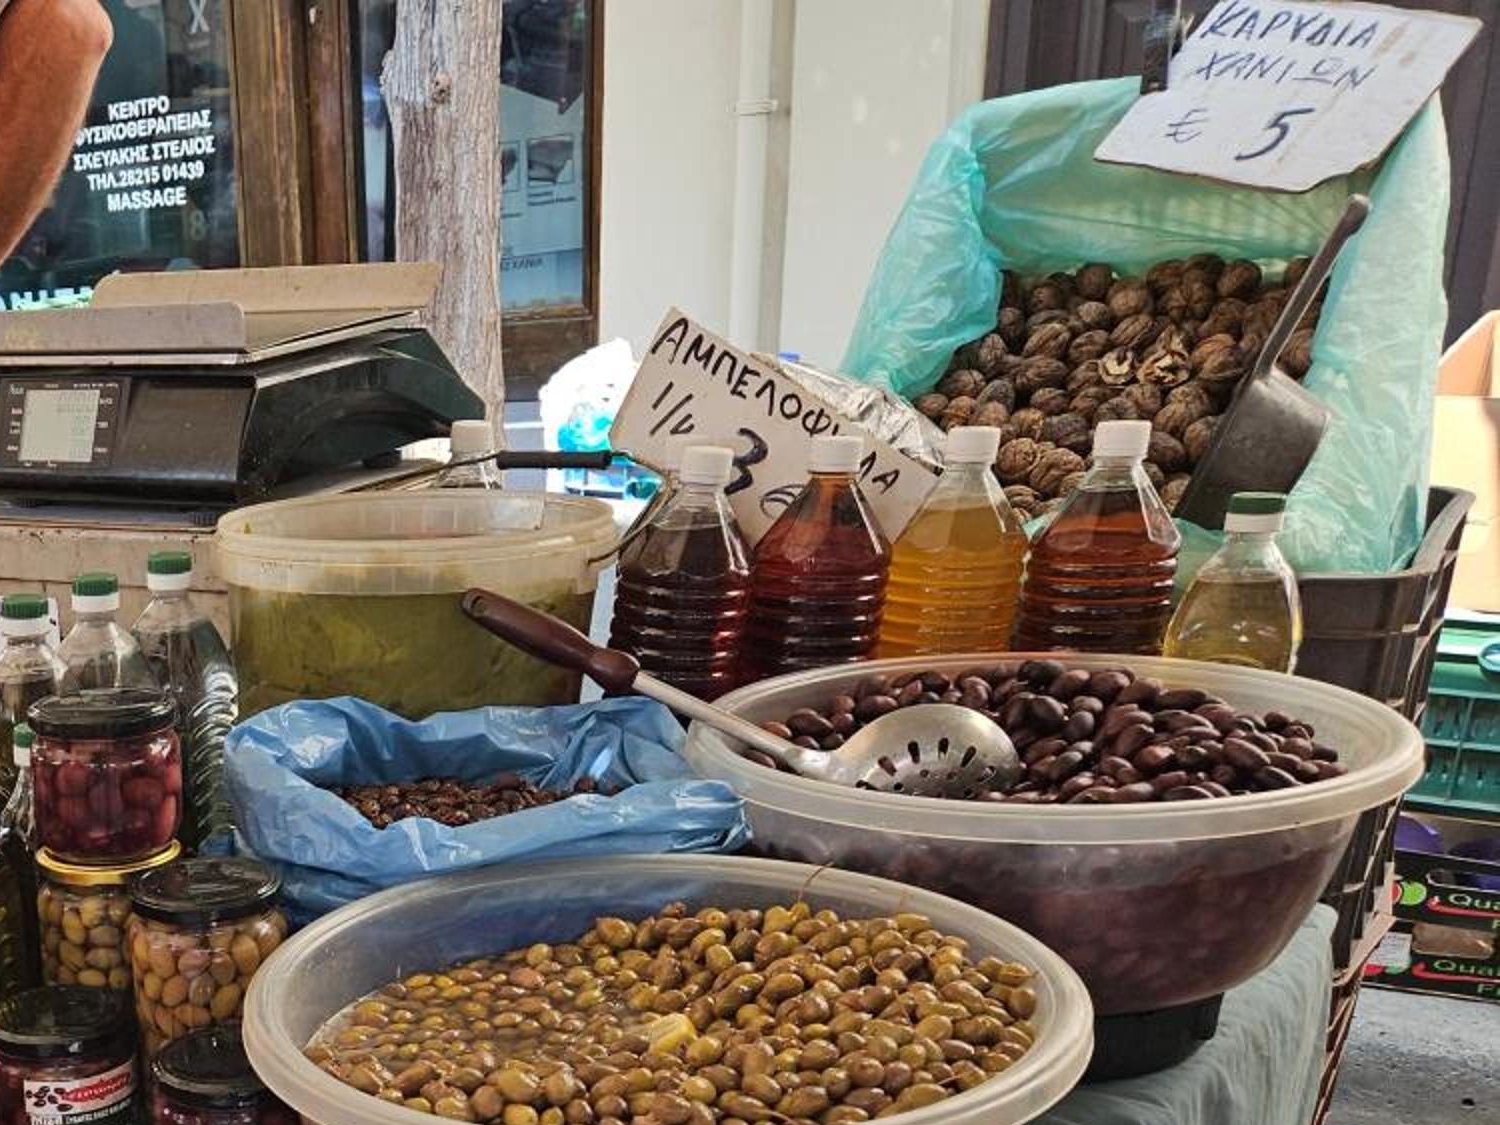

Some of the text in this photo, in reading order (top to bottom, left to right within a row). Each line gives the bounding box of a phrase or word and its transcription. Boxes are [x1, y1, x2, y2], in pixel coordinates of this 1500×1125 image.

[1200, 0, 1381, 49] ΚΑΡΥΔΙΑ
[107, 95, 170, 121] ΚΕΝΤΡΟ
[1234, 107, 1316, 161] 5
[73, 135, 216, 172] ΣΚΕΥΑΚΗΣ ΣΤΕΛΙΟΣ
[161, 159, 205, 183] 01439
[107, 186, 187, 212] MASSAGE
